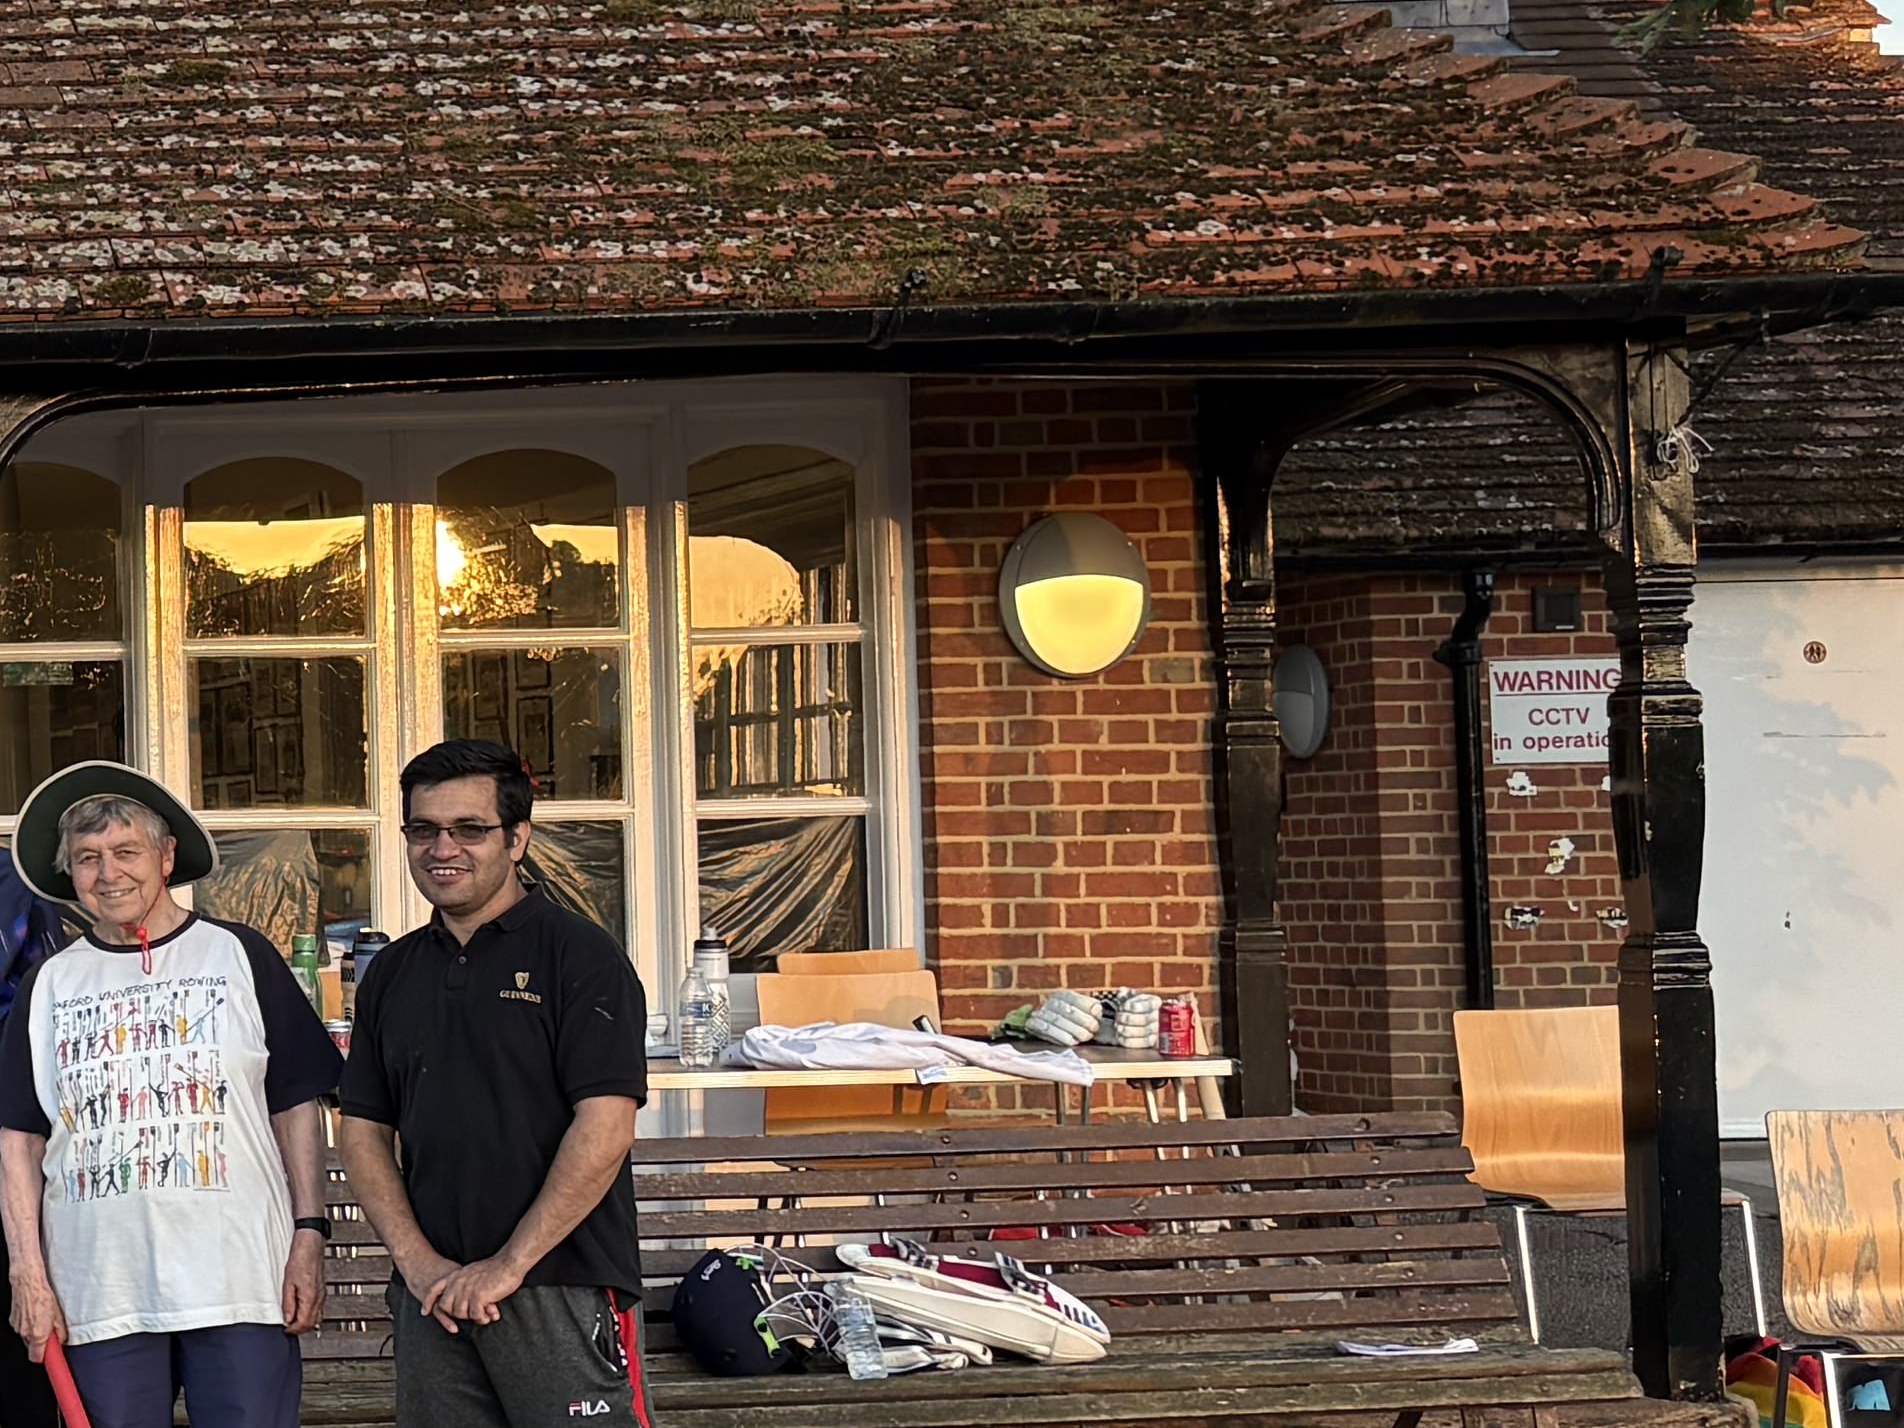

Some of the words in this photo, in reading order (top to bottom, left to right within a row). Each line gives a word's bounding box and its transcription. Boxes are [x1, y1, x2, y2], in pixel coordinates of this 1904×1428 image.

[1493, 668, 1622, 692] WARNING
[1528, 707, 1590, 726] CCTV
[1493, 733, 1512, 750] in
[1523, 731, 1610, 752] operatio
[569, 1400, 610, 1417] FILA
